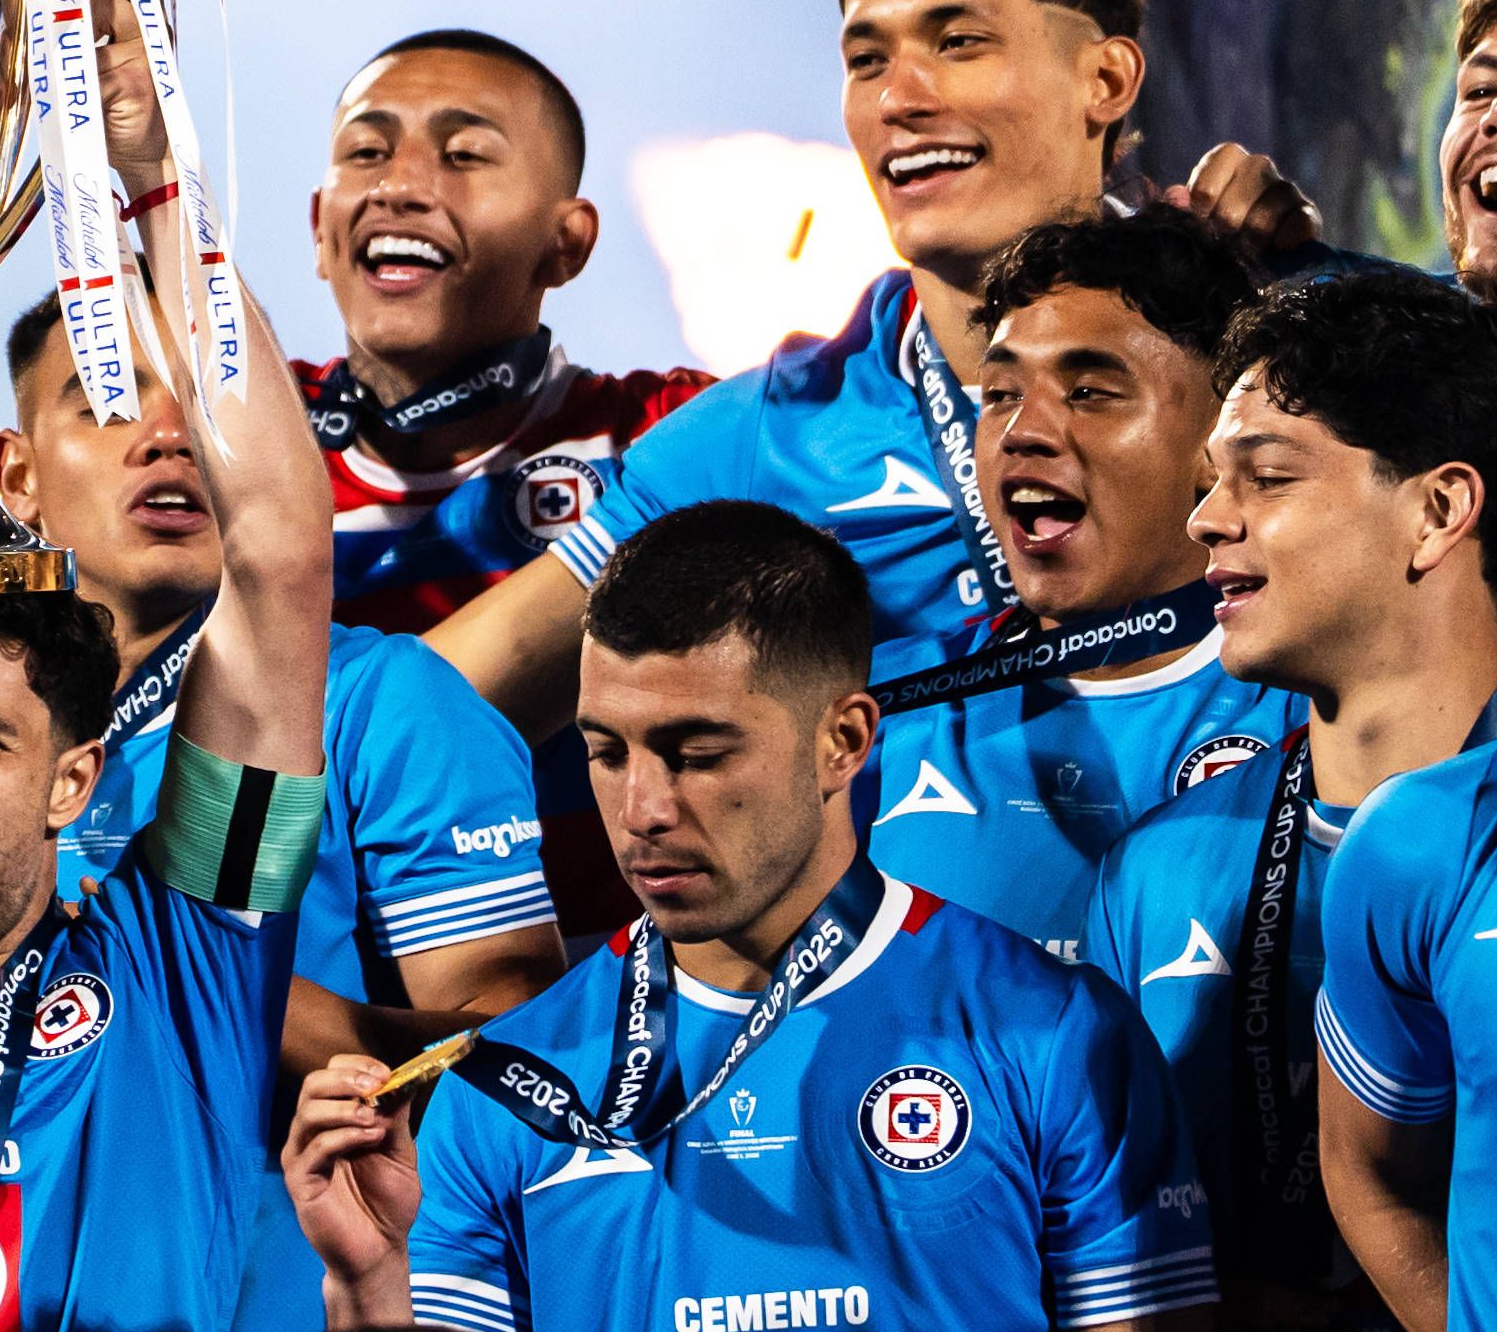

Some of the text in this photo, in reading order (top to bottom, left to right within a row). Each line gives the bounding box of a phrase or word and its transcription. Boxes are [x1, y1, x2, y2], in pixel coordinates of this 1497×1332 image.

[28, 11, 53, 126] ULTRA
[59, 30, 91, 135] ULTRA
[45, 165, 74, 271] Michelob
[175, 144, 240, 387] Michelob ULTRA
[73, 173, 125, 407] Michelob ULTRA
[395, 362, 515, 427] Concacaf
[923, 369, 1016, 590] CHAMPIONS CUP
[899, 607, 1178, 703] Concacaf CHAMPIONS
[1181, 751, 1207, 778] CLUB
[1213, 740, 1229, 749] DE
[1246, 860, 1289, 1039] CHAMPIONS
[1269, 800, 1296, 857] CUP
[748, 922, 844, 1037] CUP 2025
[41, 1019, 106, 1058] CRUZ AZUL
[499, 1059, 571, 1118] 2025
[866, 1069, 966, 1109] CLUB DE FUTBOL
[877, 1147, 952, 1169] CRUZ AZUL
